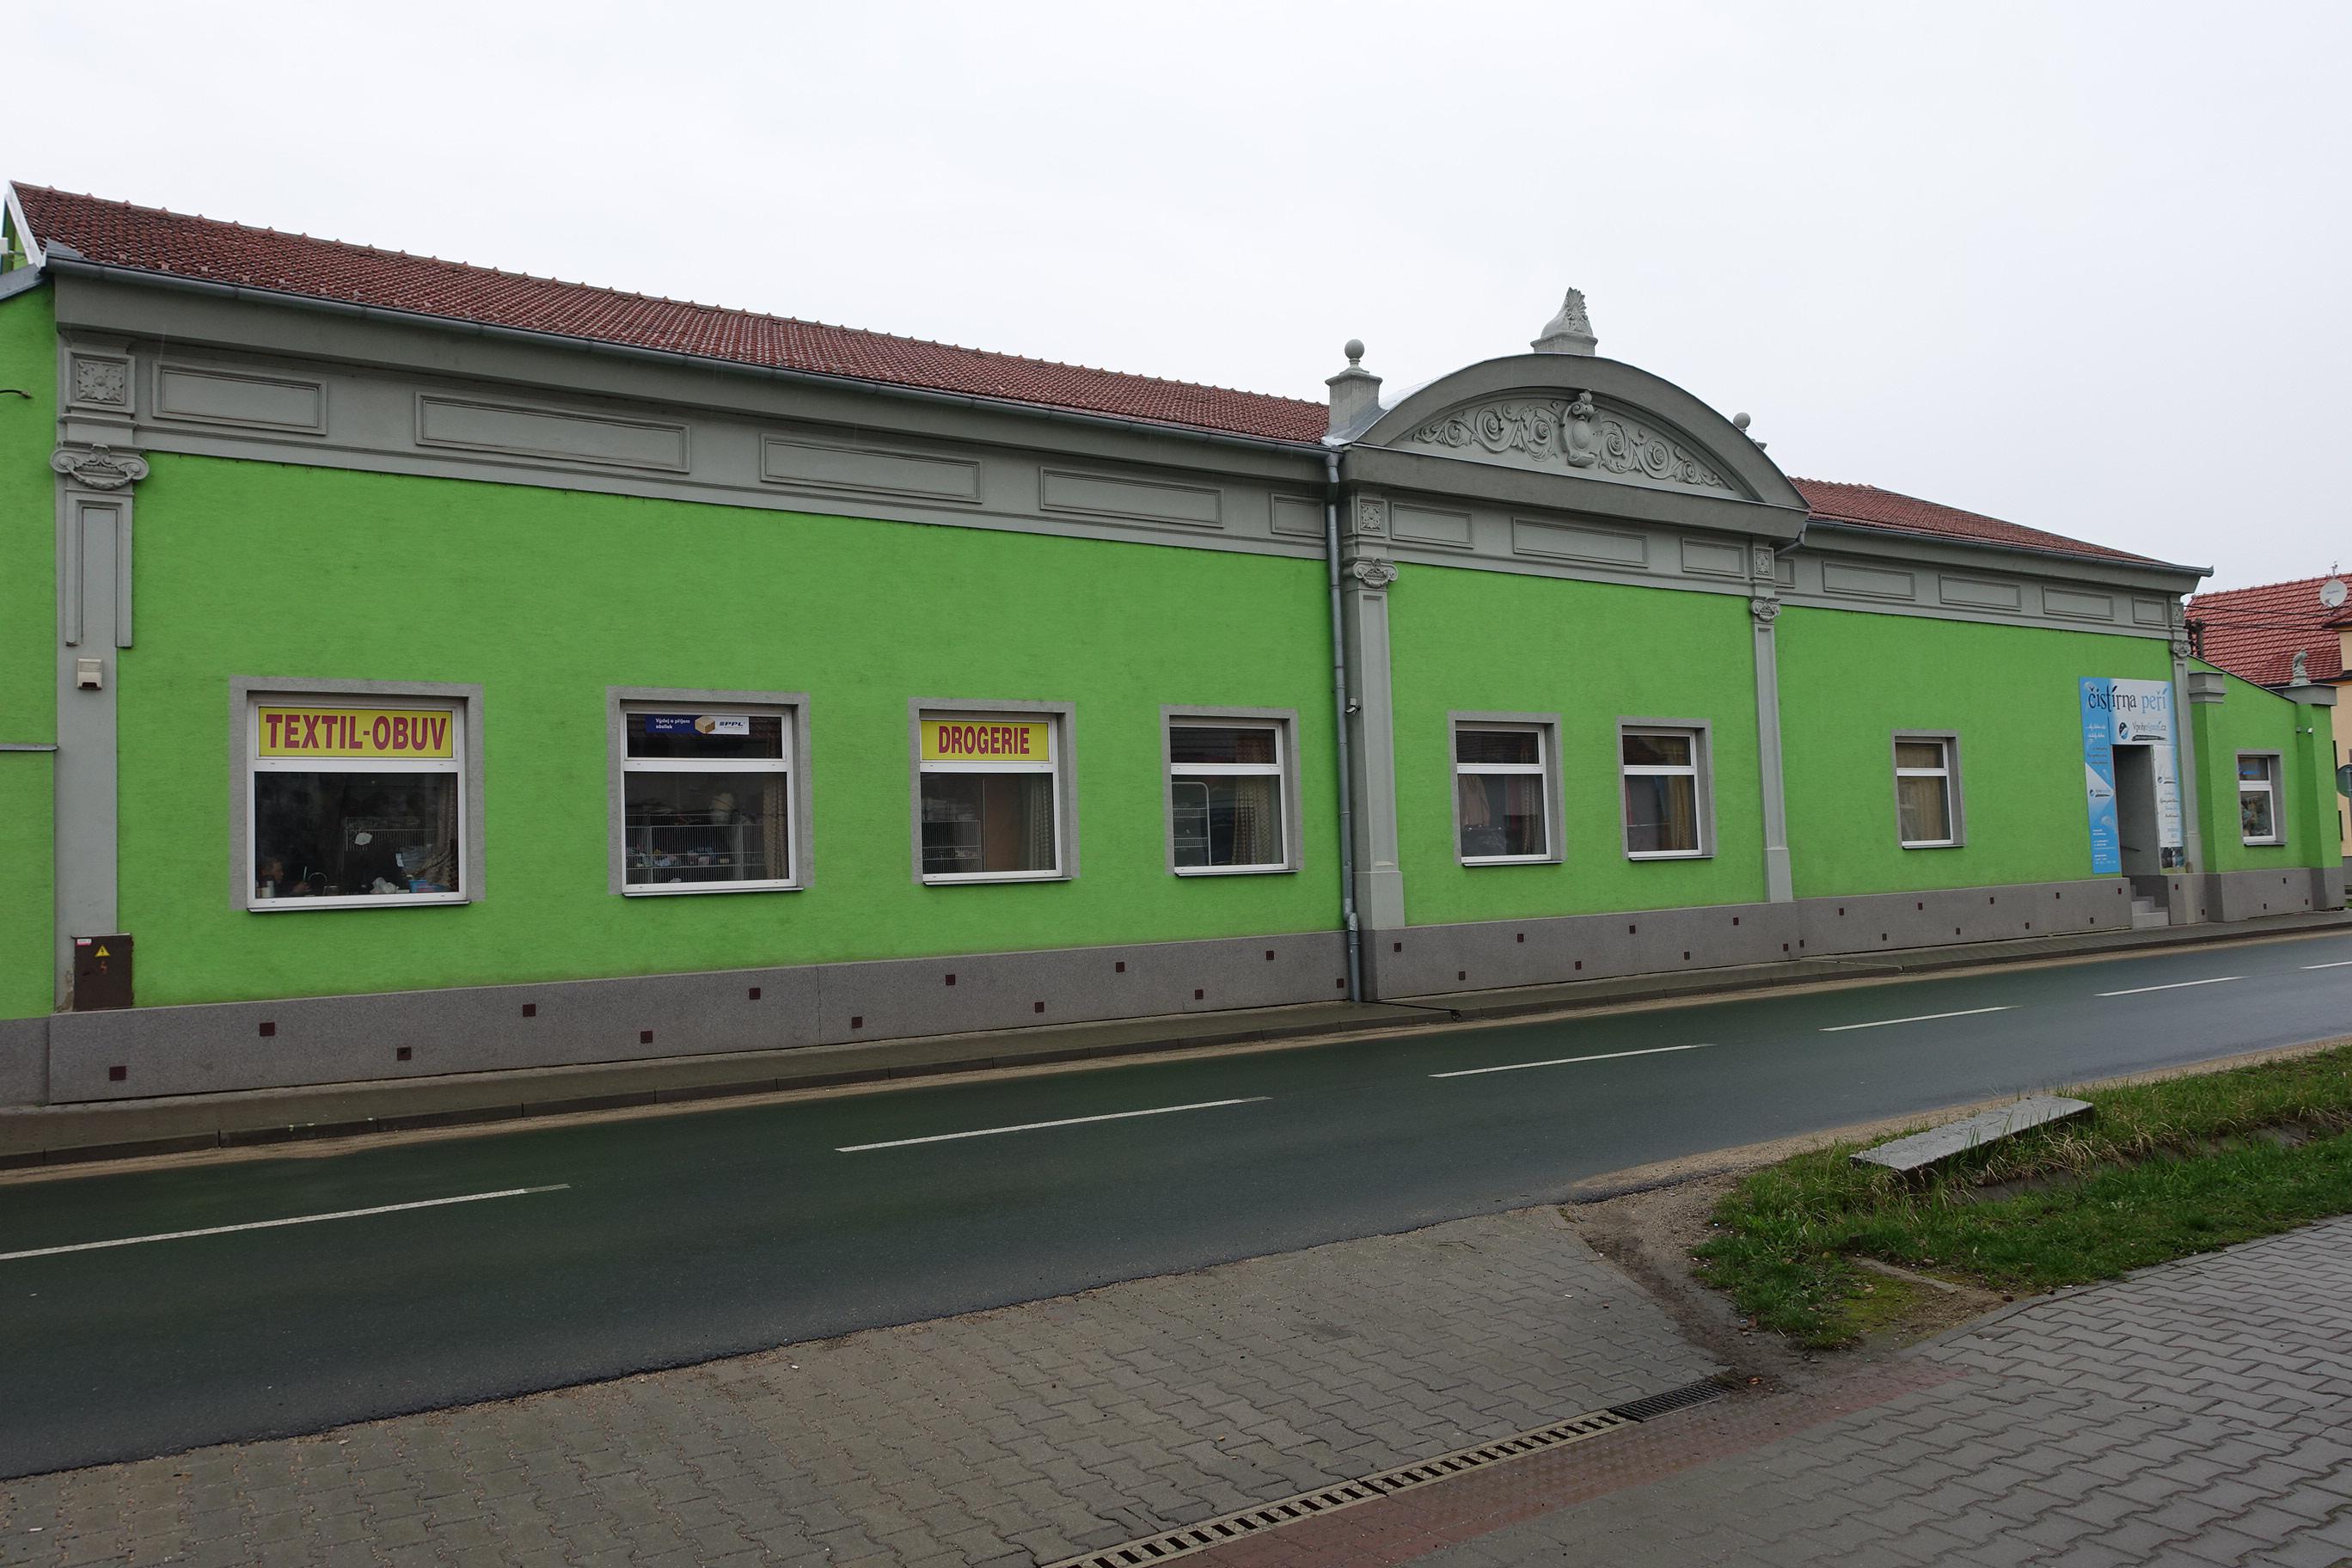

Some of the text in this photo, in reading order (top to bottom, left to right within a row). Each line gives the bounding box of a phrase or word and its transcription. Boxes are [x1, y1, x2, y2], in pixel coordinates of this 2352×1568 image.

[2088, 684, 2168, 714] čistírna peří
[266, 714, 447, 751] TEXTIL-OBUV
[938, 726, 1030, 755] DROGERIE
